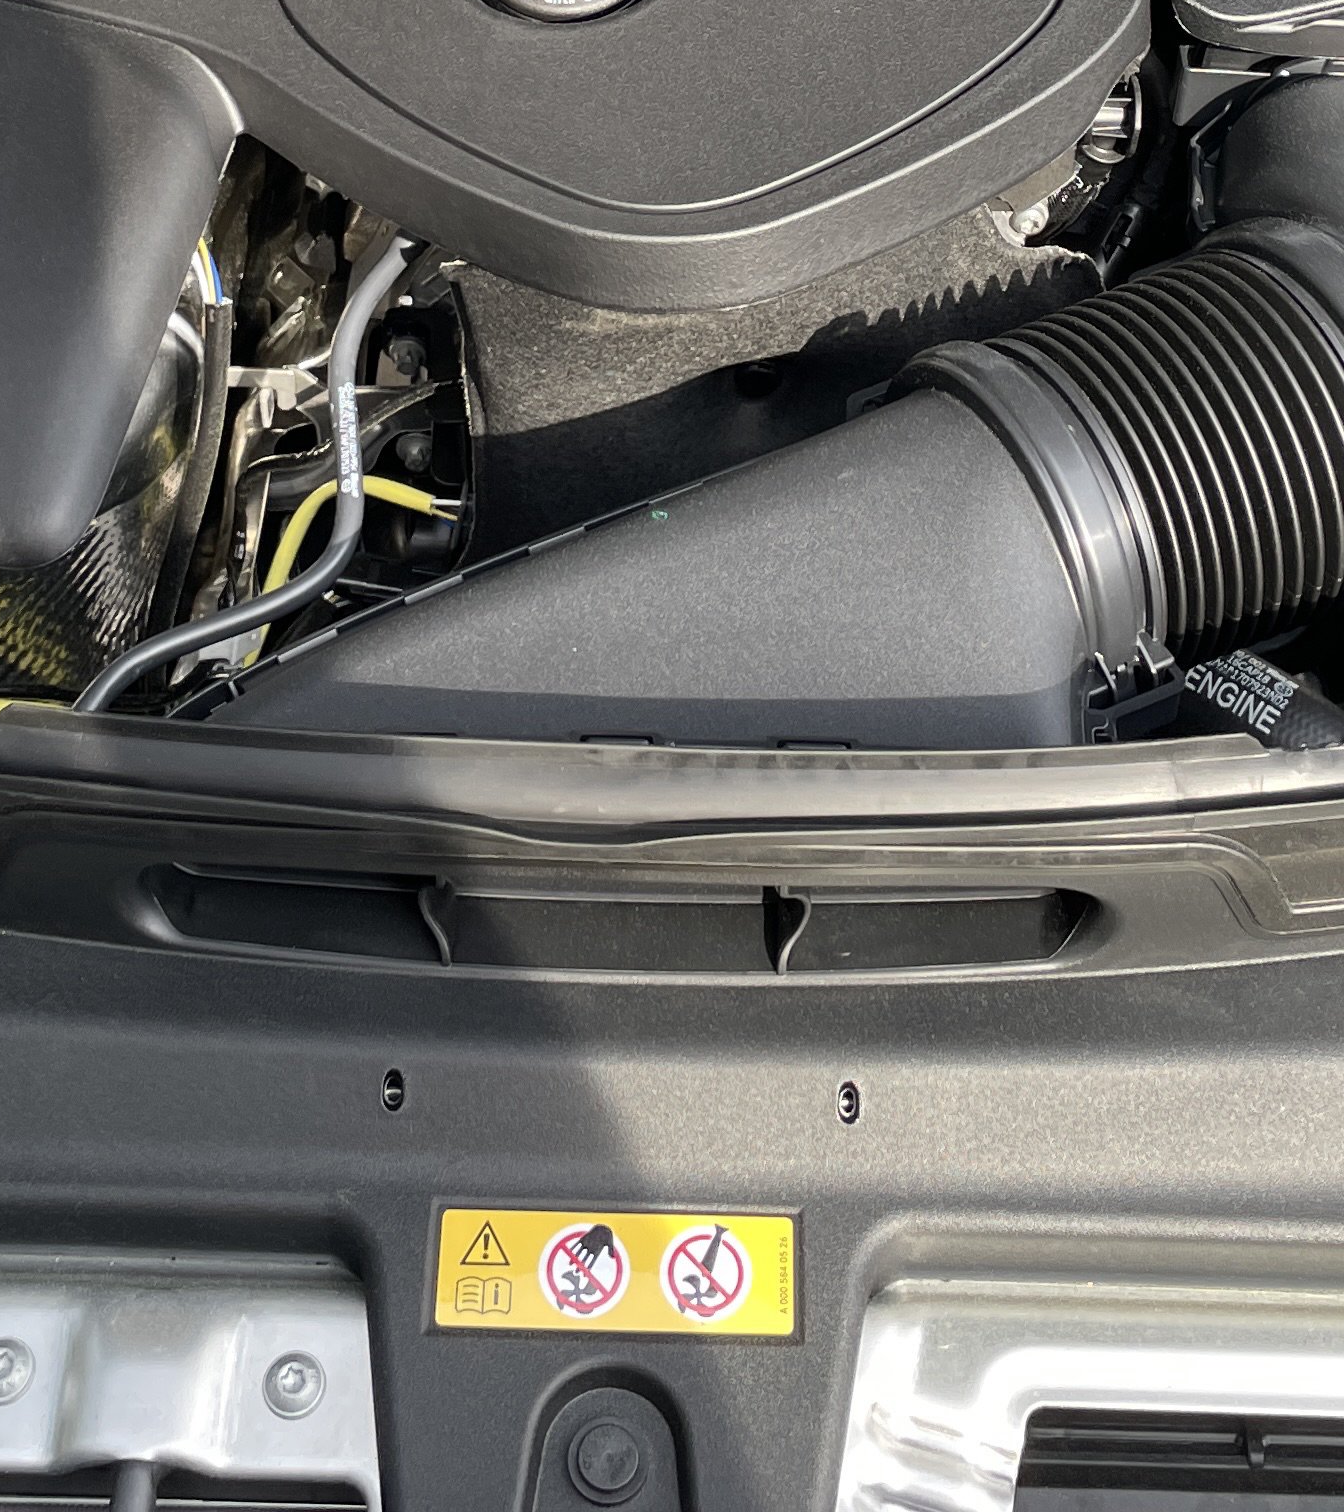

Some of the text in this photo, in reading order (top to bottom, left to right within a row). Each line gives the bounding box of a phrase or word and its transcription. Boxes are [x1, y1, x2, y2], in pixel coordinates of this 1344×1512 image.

[1184, 663, 1282, 735] ENGINE
[779, 1235, 789, 1249] 26
[779, 1250, 789, 1264] 05
[779, 1286, 789, 1306] 000
